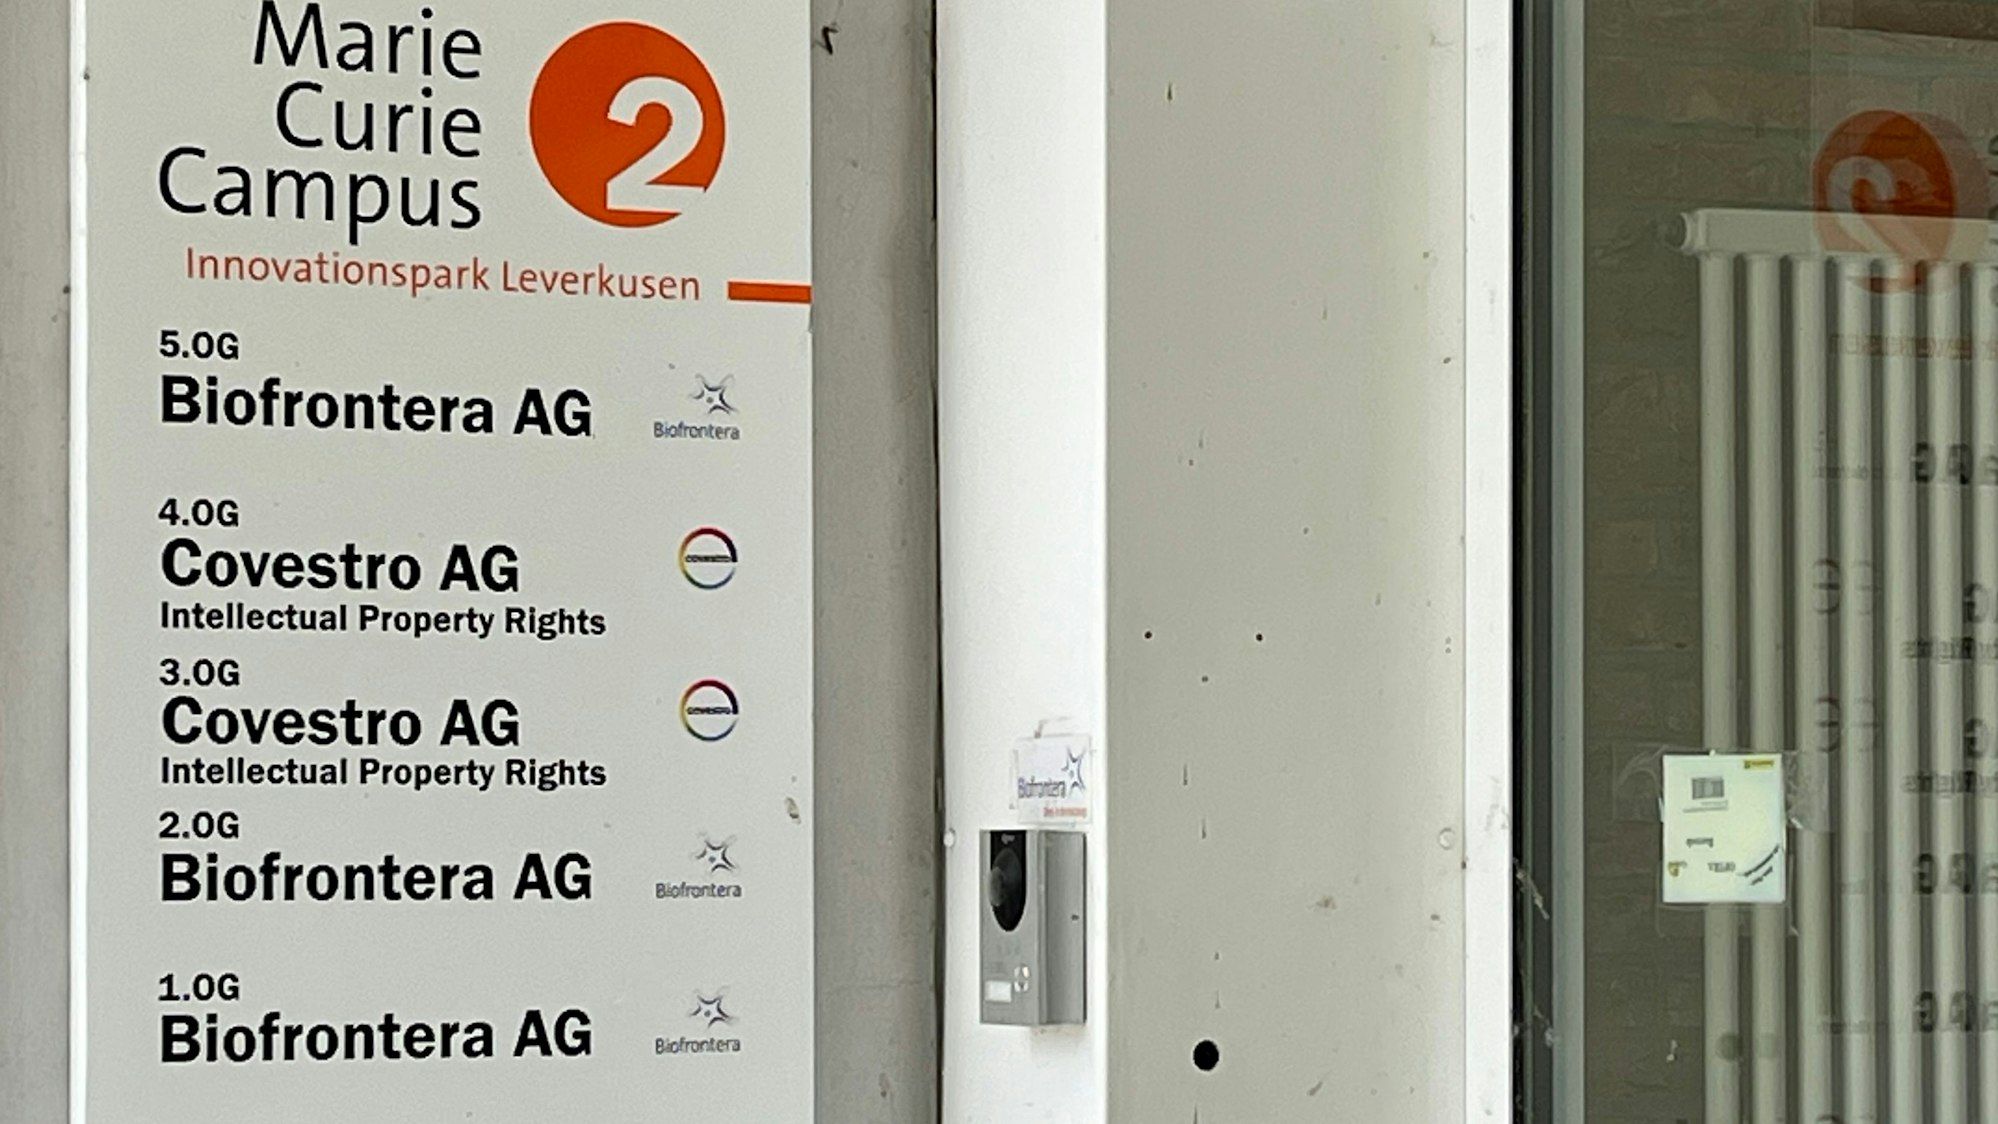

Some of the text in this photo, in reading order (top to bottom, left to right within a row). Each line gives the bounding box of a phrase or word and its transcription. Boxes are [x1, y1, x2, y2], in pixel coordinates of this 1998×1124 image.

[253, 0, 482, 79] Marie
[276, 81, 482, 158] Curie
[606, 75, 706, 213] 2
[159, 146, 482, 245] Campus
[186, 247, 701, 301] Innovationspark Leverkusen
[159, 329, 240, 360] 5.OG
[161, 374, 592, 437] Biofrontera AG
[653, 421, 740, 440] Biofrontera
[157, 498, 240, 528] 4.OG
[161, 537, 519, 593] Covestro AG
[161, 602, 607, 640] Intellectual Property Rights
[159, 658, 240, 687] 3.OG
[162, 695, 519, 747] Covestro AG
[161, 756, 607, 791] Intellectual Property Rights
[158, 810, 240, 839] 2.OG
[161, 851, 592, 902] Biofrontera AG
[655, 880, 742, 899] Biofrontera
[158, 972, 240, 1002] 1.OG
[161, 1009, 592, 1063] Biofrontera AG
[655, 1035, 741, 1055] Biofrontera
